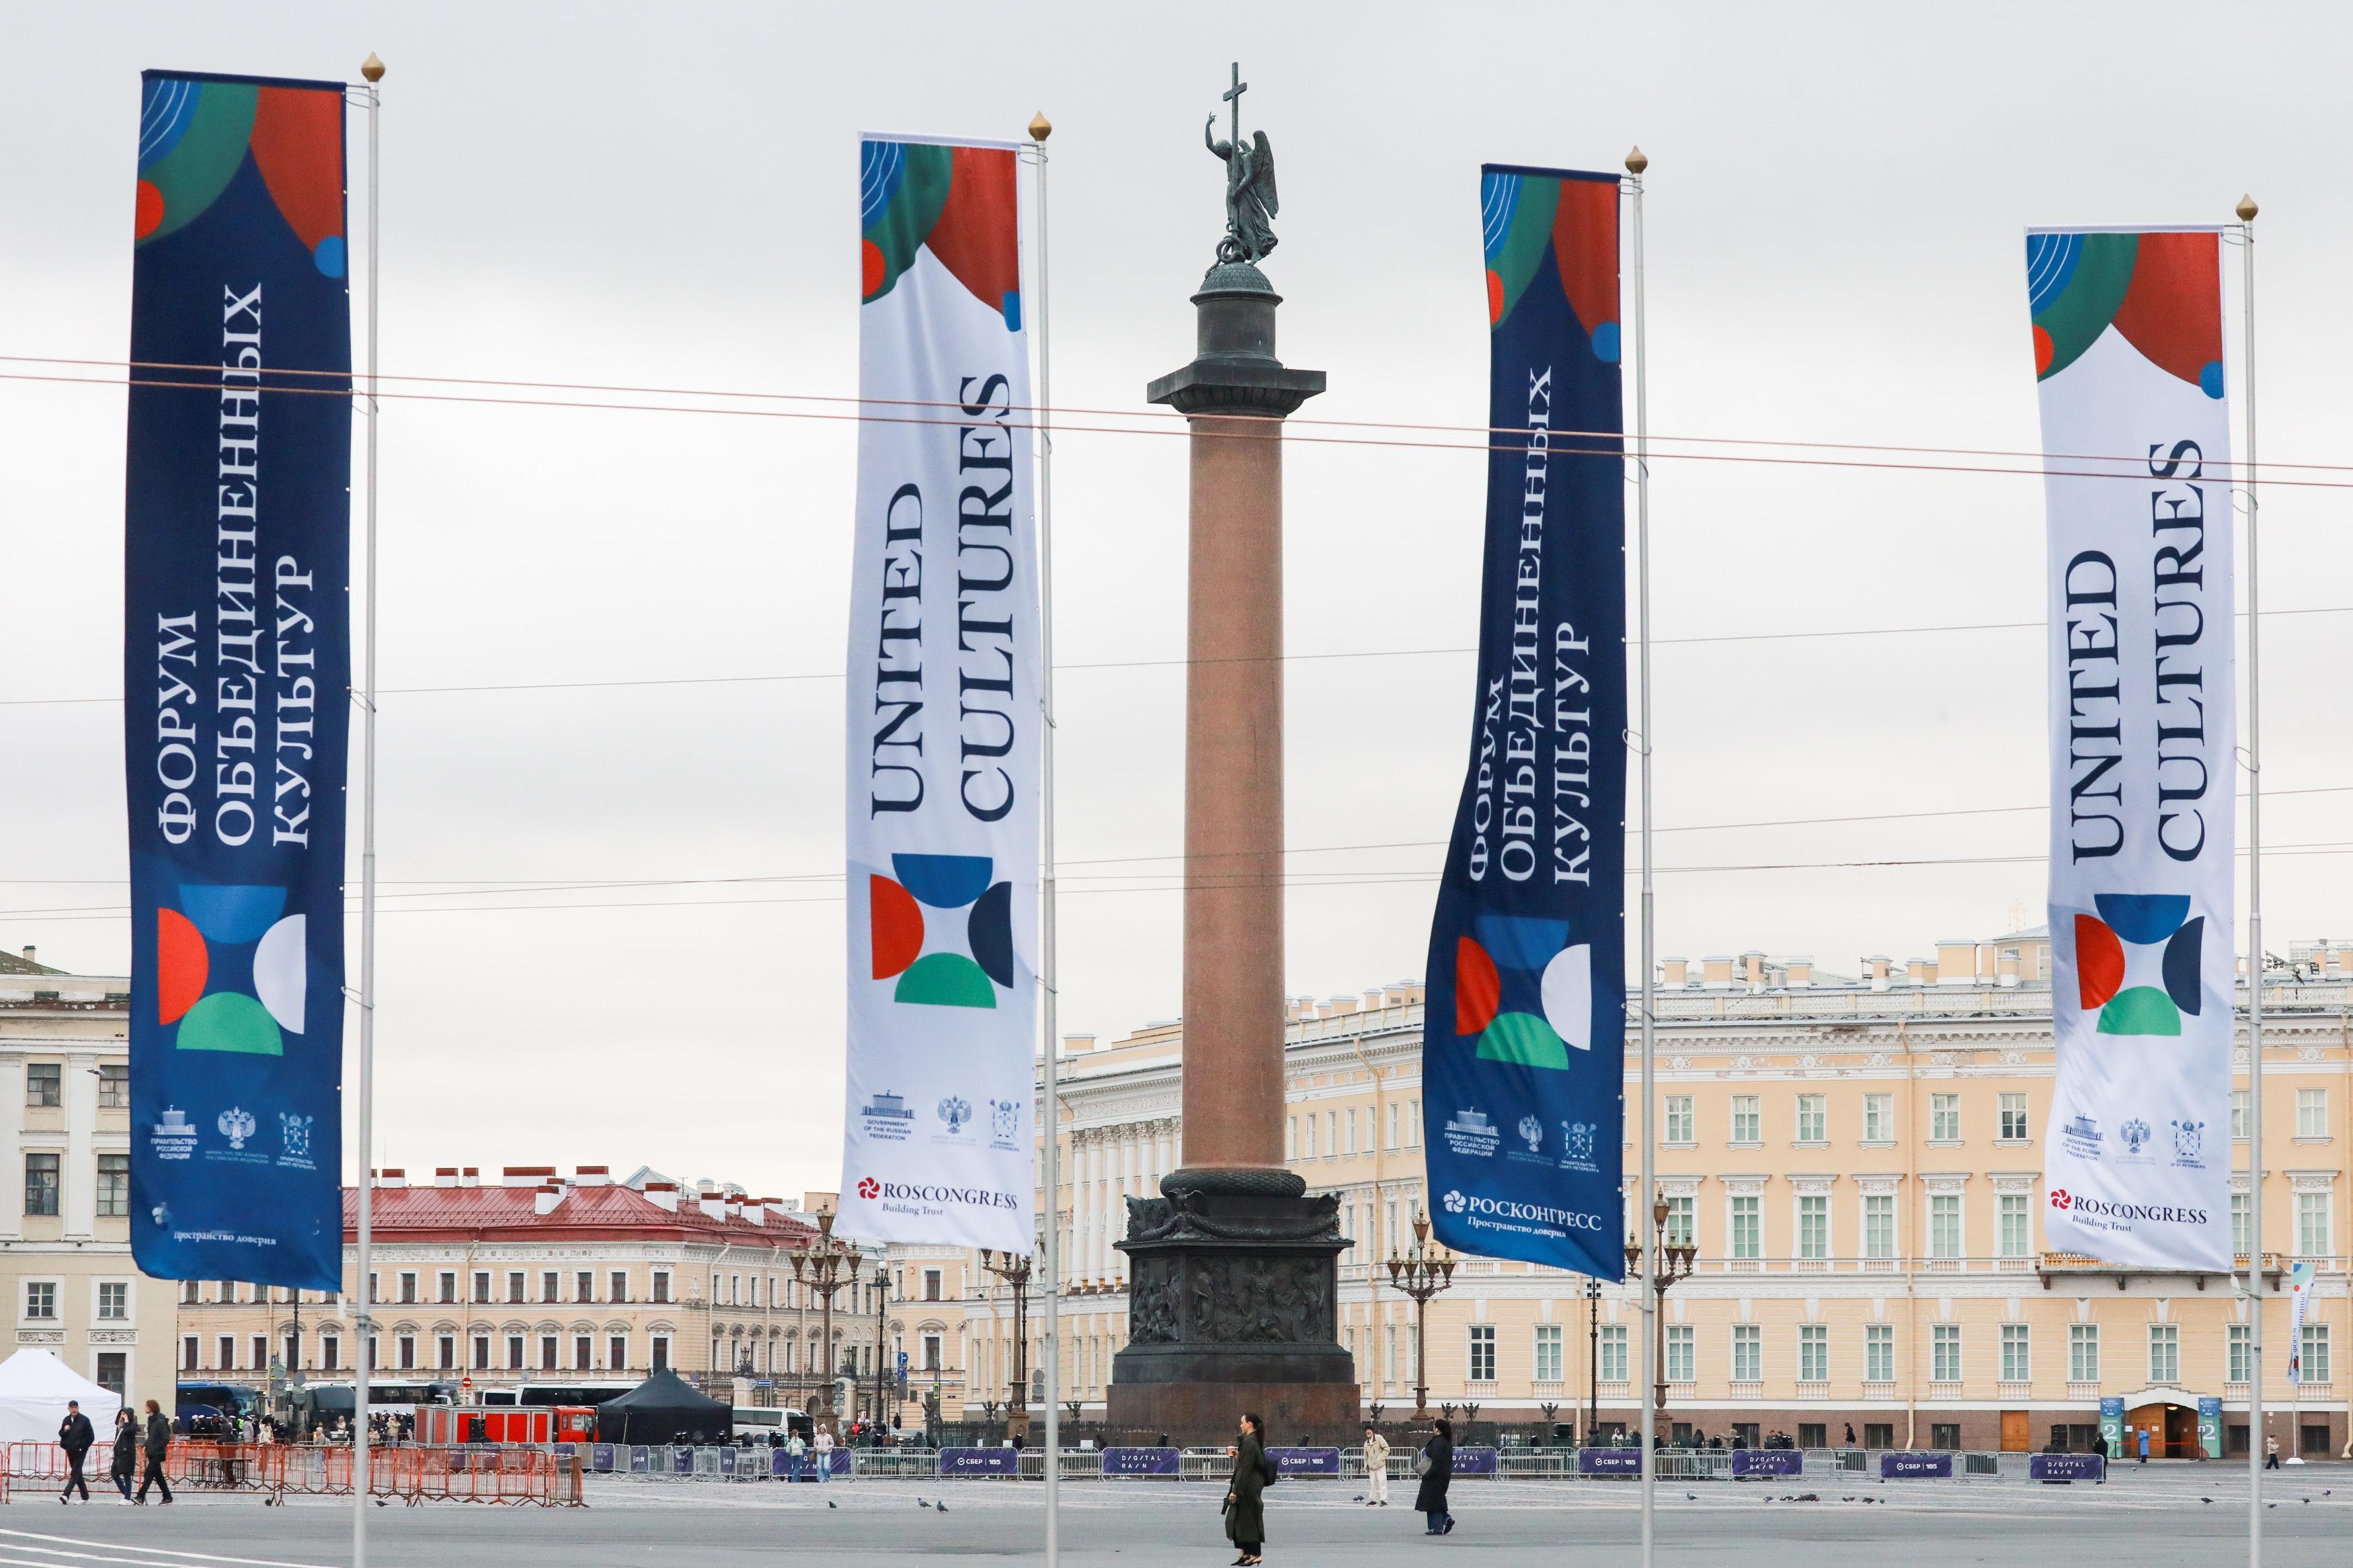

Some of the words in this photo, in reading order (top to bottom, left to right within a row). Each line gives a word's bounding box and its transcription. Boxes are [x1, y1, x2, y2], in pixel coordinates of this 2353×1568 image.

[216, 283, 266, 846] ОБЪЕДИНЕННЫХ
[957, 374, 1014, 822] CULTURES
[1501, 366, 1552, 882] ОБЪЕДИНЕННЫХ
[872, 483, 924, 821] UNITED
[2149, 440, 2207, 862] CULTURES
[273, 555, 315, 849] КУЛЬТУР
[2066, 550, 2124, 866] UNITED
[158, 611, 197, 844] ФОРУМ
[1554, 622, 1590, 886] КУЛЬТУР
[1470, 675, 1504, 882] ФОРУМ
[867, 1119, 908, 1128] GOVERNMENT
[1444, 1132, 1500, 1145] ПРАВИТЕЛЬСТВО
[1449, 1139, 1495, 1151] РОССИЙСКОЙ
[1452, 1147, 1492, 1157] ФЕДЕРАЦИИ
[2066, 1149, 2098, 1161] FEDERATION
[882, 1203, 920, 1216] Building
[922, 1206, 943, 1216] Trust
[883, 1183, 1018, 1210] ROSCONGRESS
[2074, 1196, 2207, 1225] ROSCONGRESS
[1468, 1216, 1532, 1233] Пространство
[1469, 1196, 1602, 1231] РОСКОНГРЕСС
[2072, 1214, 2108, 1230] Building
[2110, 1221, 2132, 1232] Trust
[2104, 1424, 2118, 1440] 2
[2202, 1424, 2217, 1440] 2
